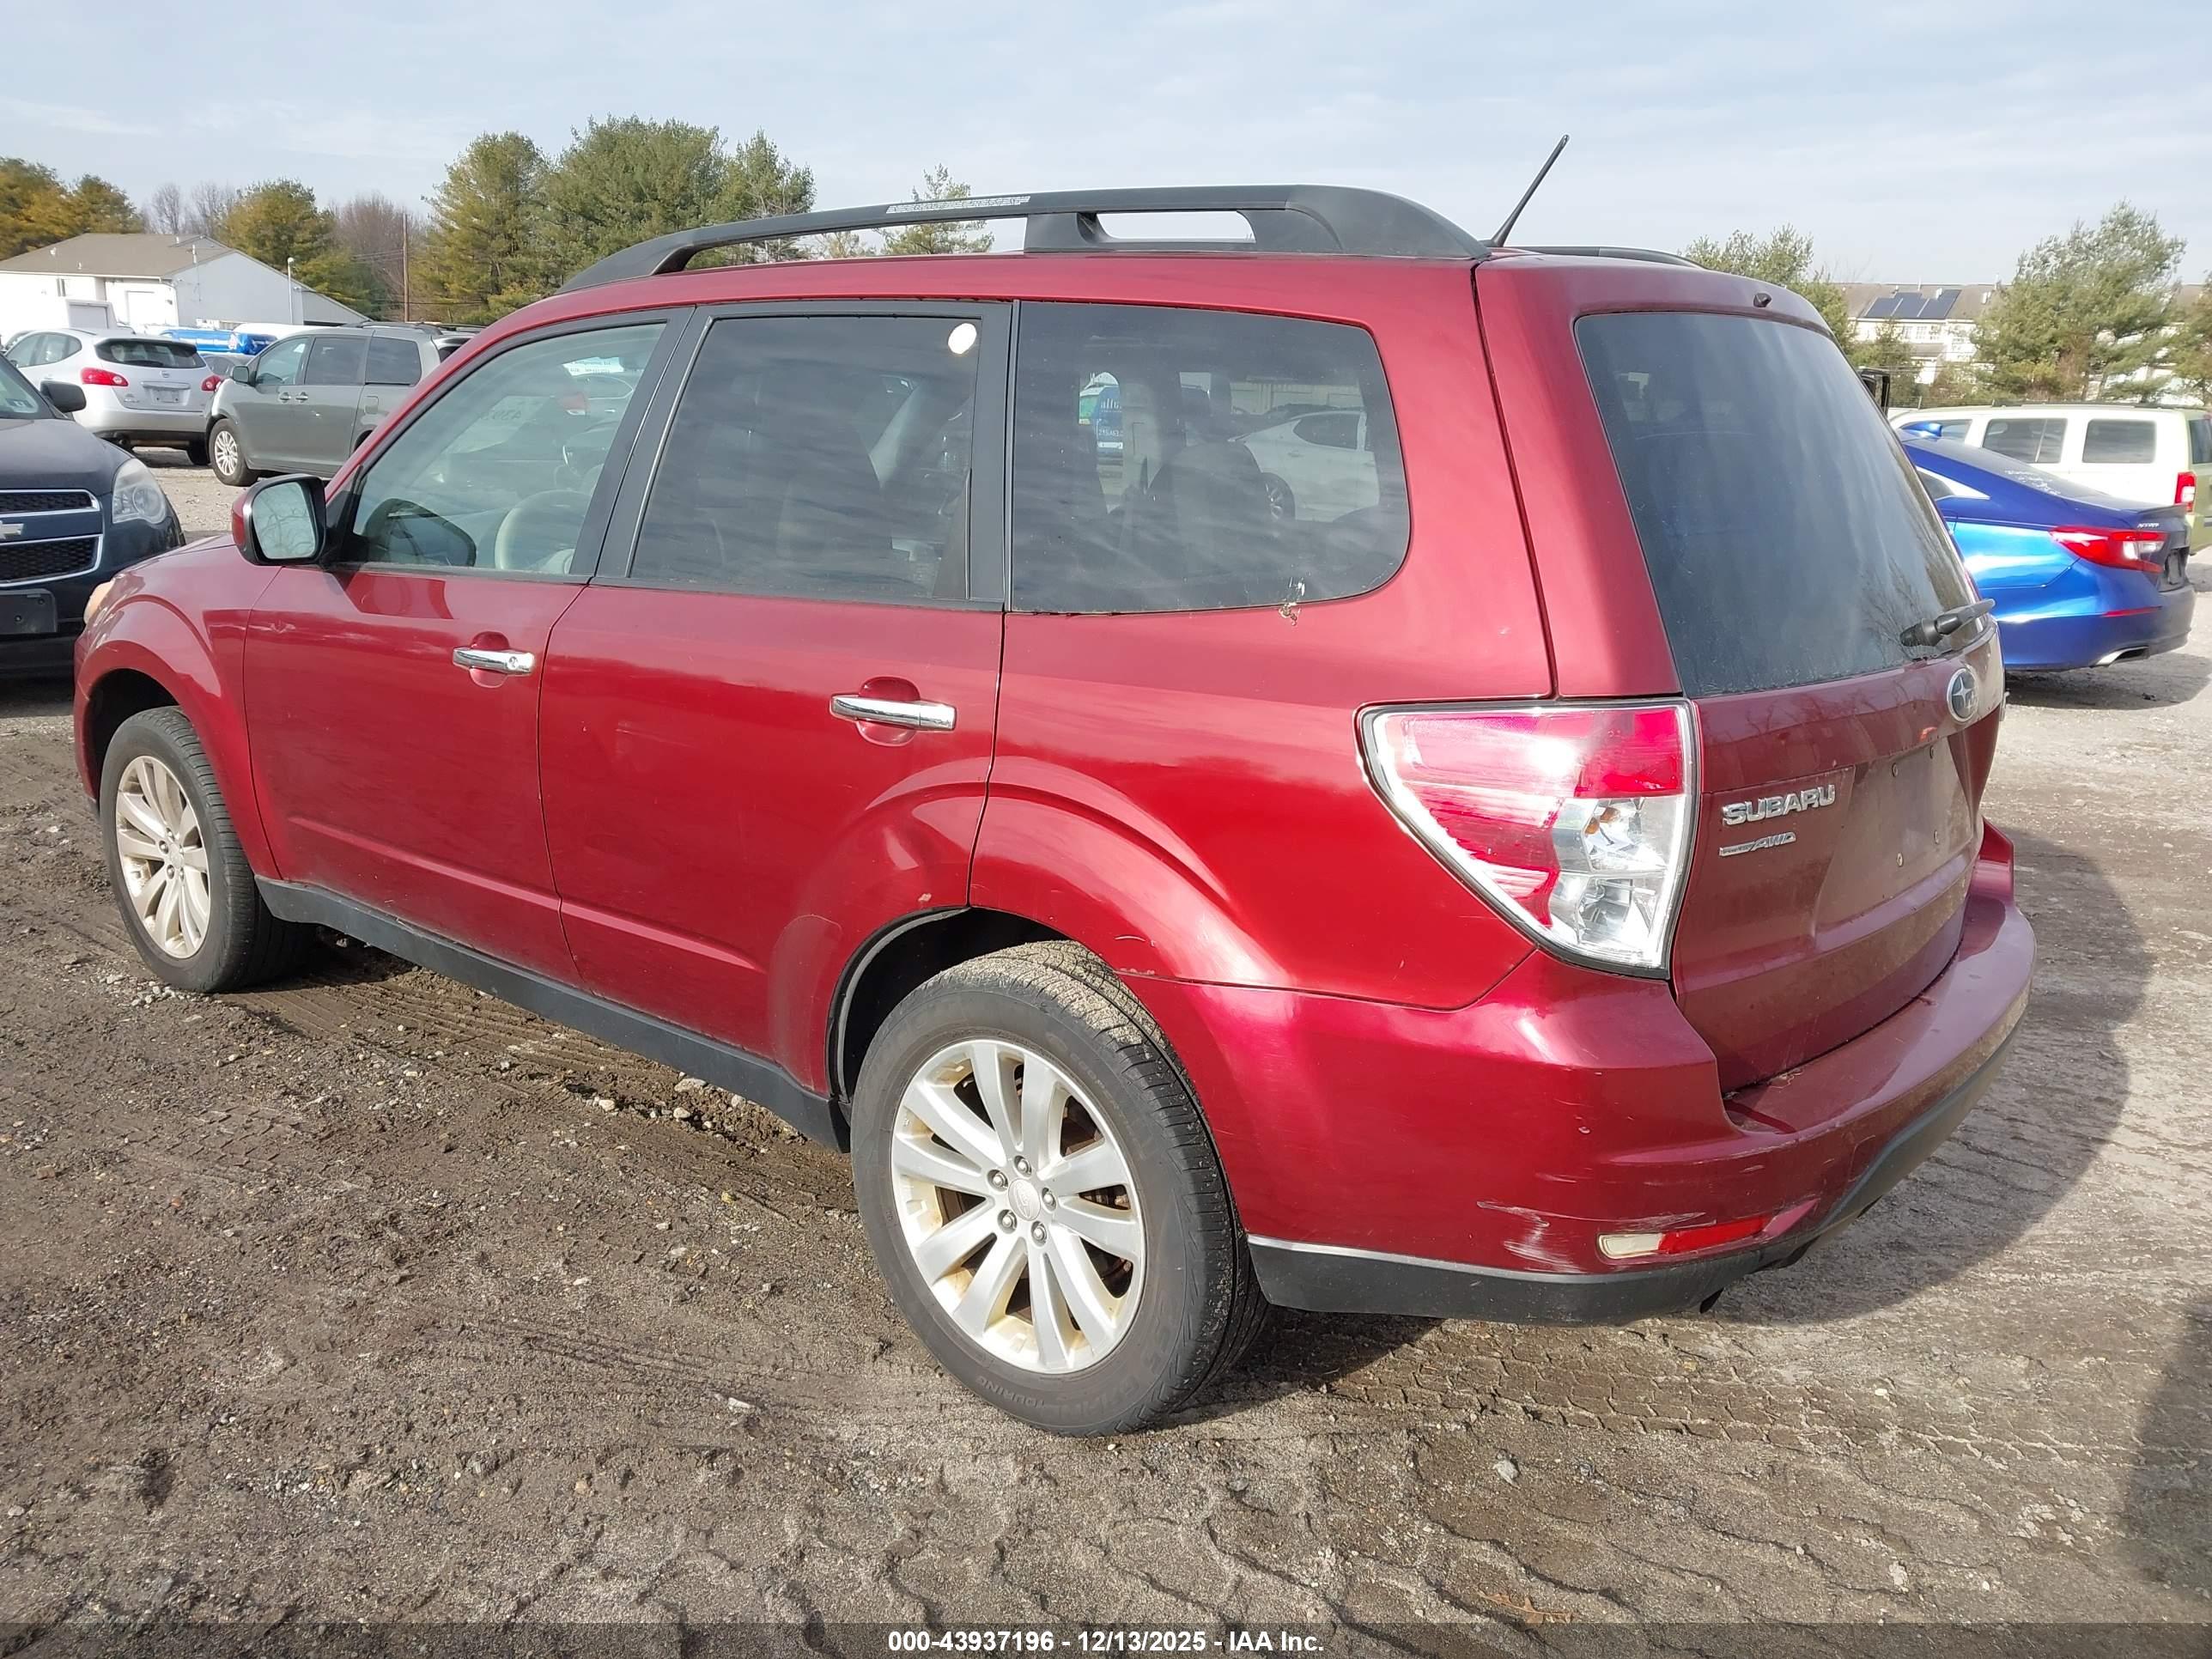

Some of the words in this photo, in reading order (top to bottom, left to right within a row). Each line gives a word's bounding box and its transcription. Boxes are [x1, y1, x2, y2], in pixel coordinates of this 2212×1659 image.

[1722, 784, 1836, 826] SUBARU
[1750, 831, 1797, 852] AWD
[975, 1375, 1046, 1408] TOURING
